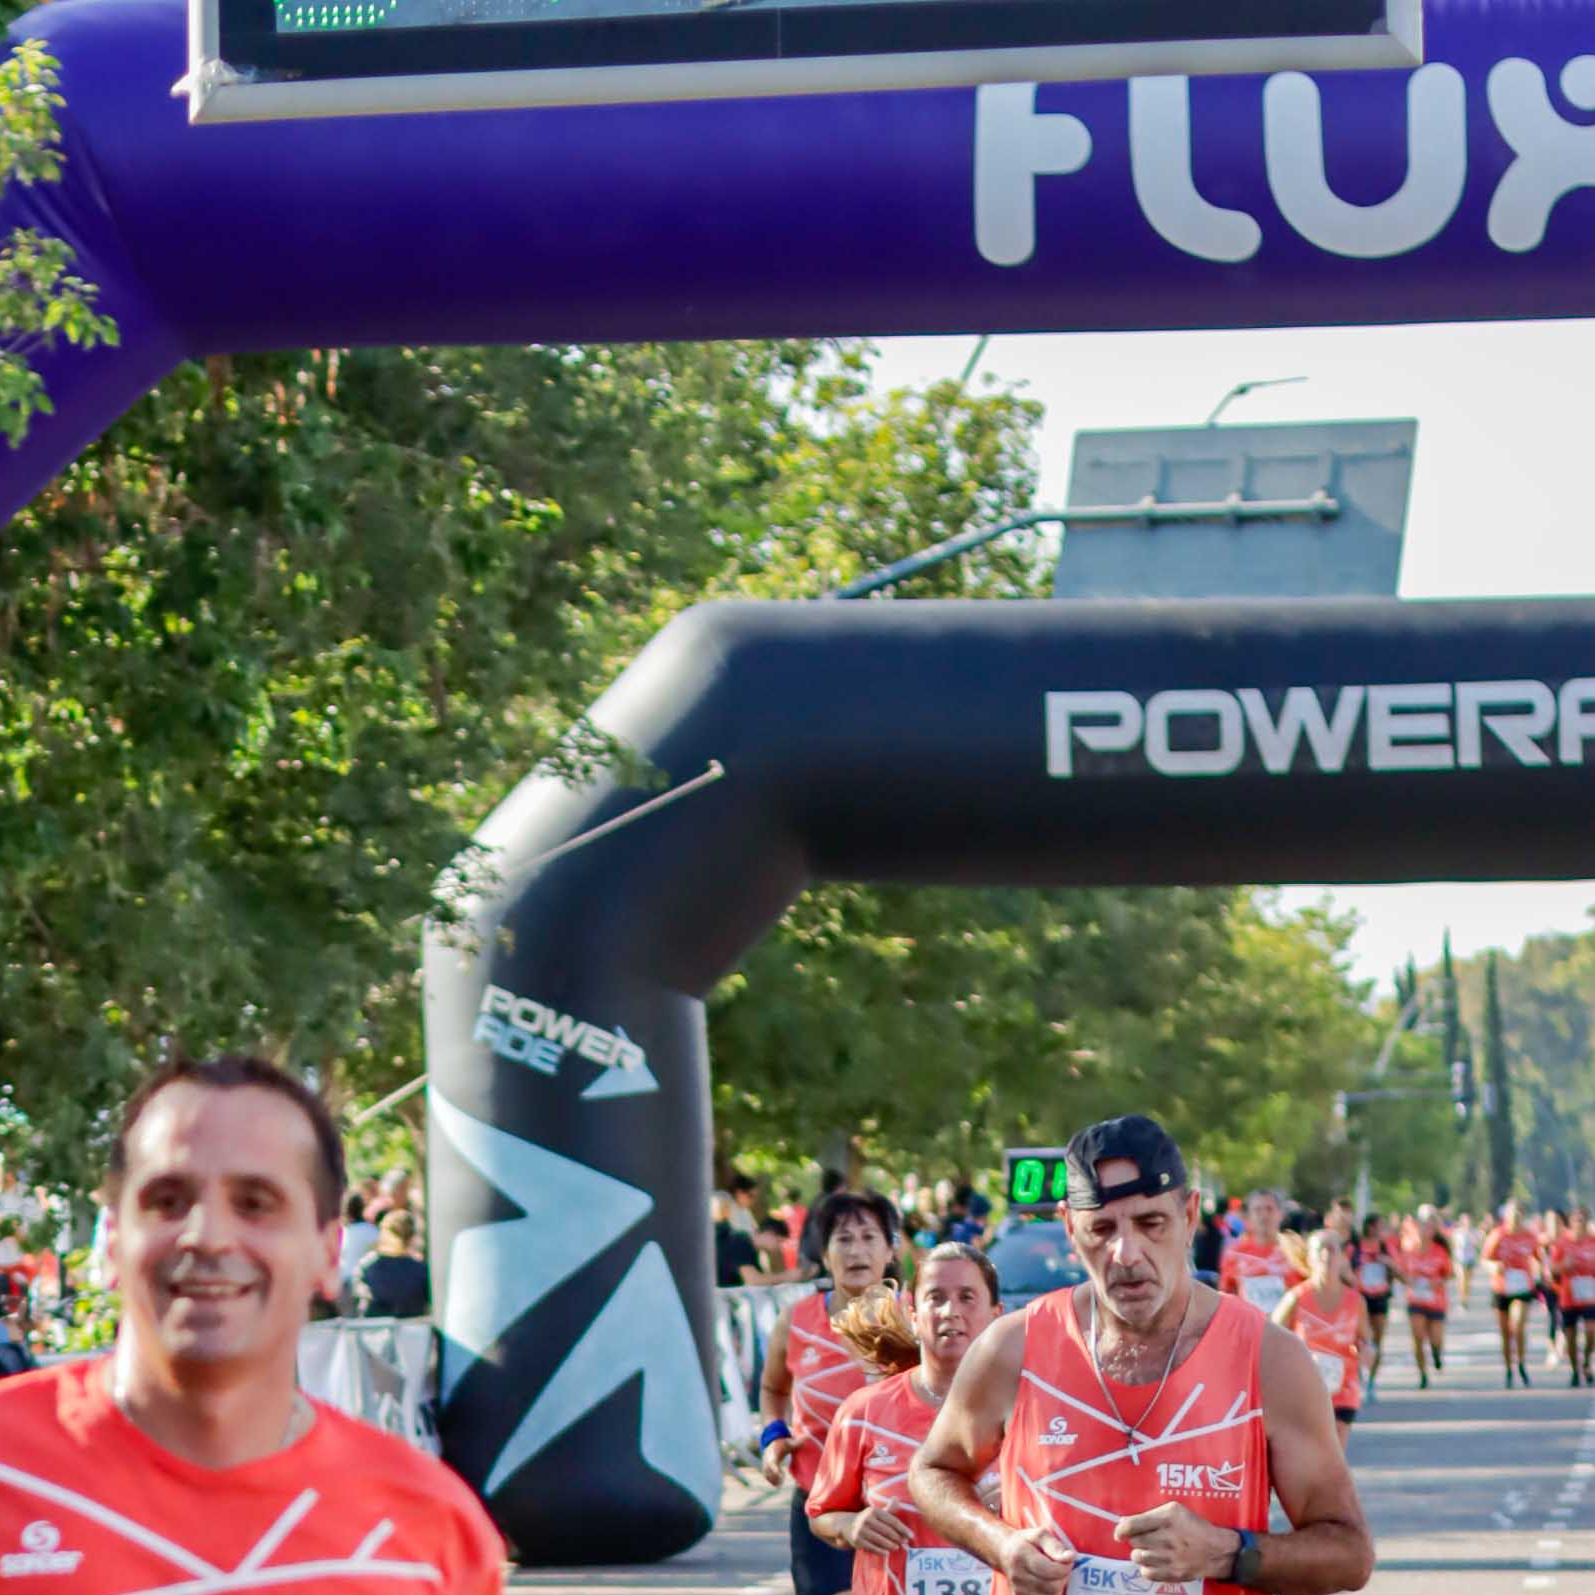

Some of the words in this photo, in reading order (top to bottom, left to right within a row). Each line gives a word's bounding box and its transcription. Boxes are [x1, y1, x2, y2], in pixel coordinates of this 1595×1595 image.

[480, 983, 646, 1073] POWER
[1156, 1463, 1205, 1489] 15K
[1079, 1567, 1116, 1589] 15K
